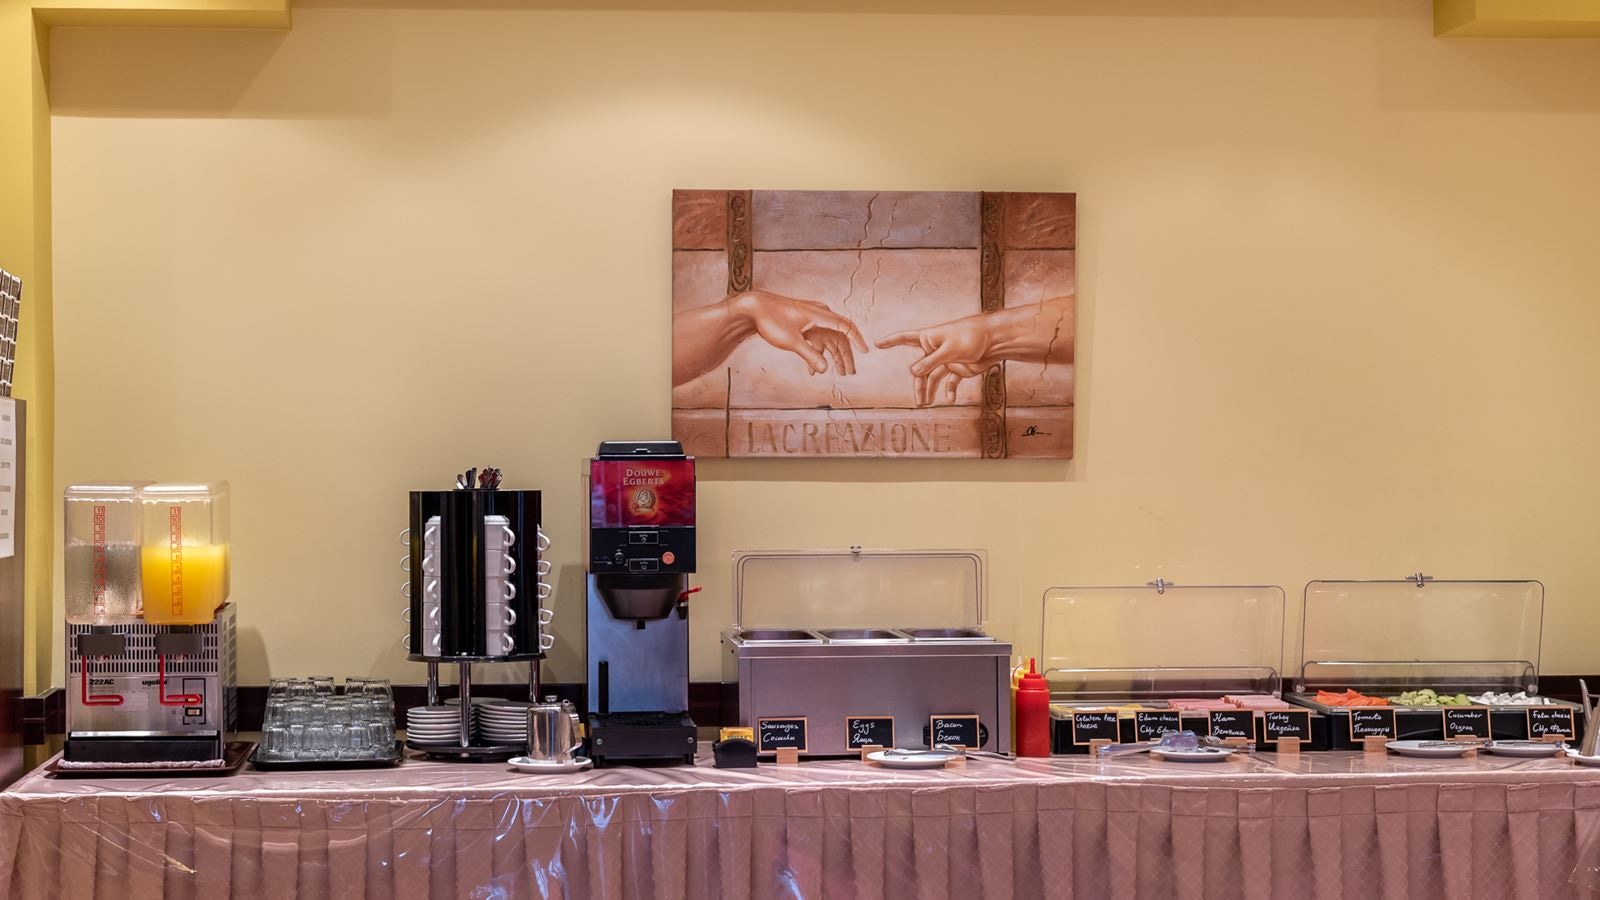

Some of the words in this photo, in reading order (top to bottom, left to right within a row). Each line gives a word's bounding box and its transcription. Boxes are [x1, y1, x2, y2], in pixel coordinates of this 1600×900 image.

[626, 469, 661, 477] DOUWE
[623, 478, 665, 486] EGBERTS
[89, 678, 115, 686] 222AC
[1075, 714, 1102, 722] Gluten
[1138, 713, 1158, 721] Edam
[1267, 713, 1290, 723] Turkey
[1352, 711, 1382, 721] Tomato
[1447, 711, 1482, 719] Cucumber
[1532, 710, 1550, 719] Feta
[1551, 711, 1571, 719] cheese
[852, 720, 876, 734] Eggs
[936, 720, 963, 729] Bacon
